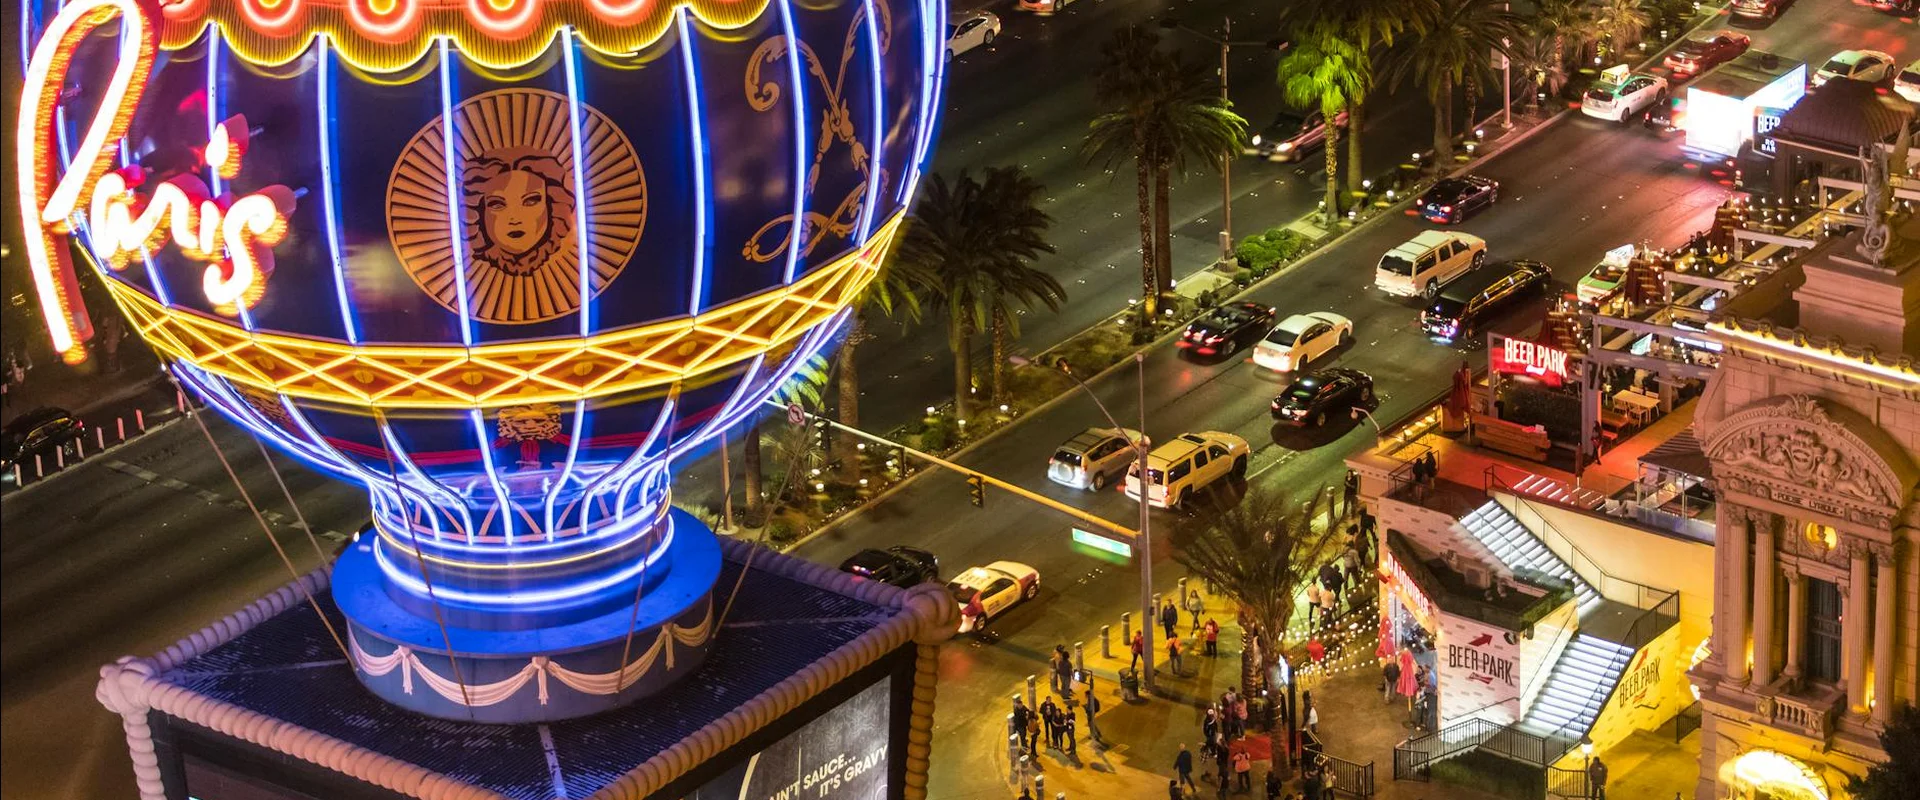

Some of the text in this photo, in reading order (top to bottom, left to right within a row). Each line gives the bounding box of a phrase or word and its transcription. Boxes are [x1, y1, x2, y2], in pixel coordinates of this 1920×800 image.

[17, 0, 290, 360] Paris
[1504, 337, 1568, 378] BEER PARK
[1449, 644, 1514, 686] BEER PARK
[1619, 656, 1661, 709] BEER PARK
[803, 753, 856, 790] SAUCE...
[819, 744, 888, 798] IT'S GRAVY
